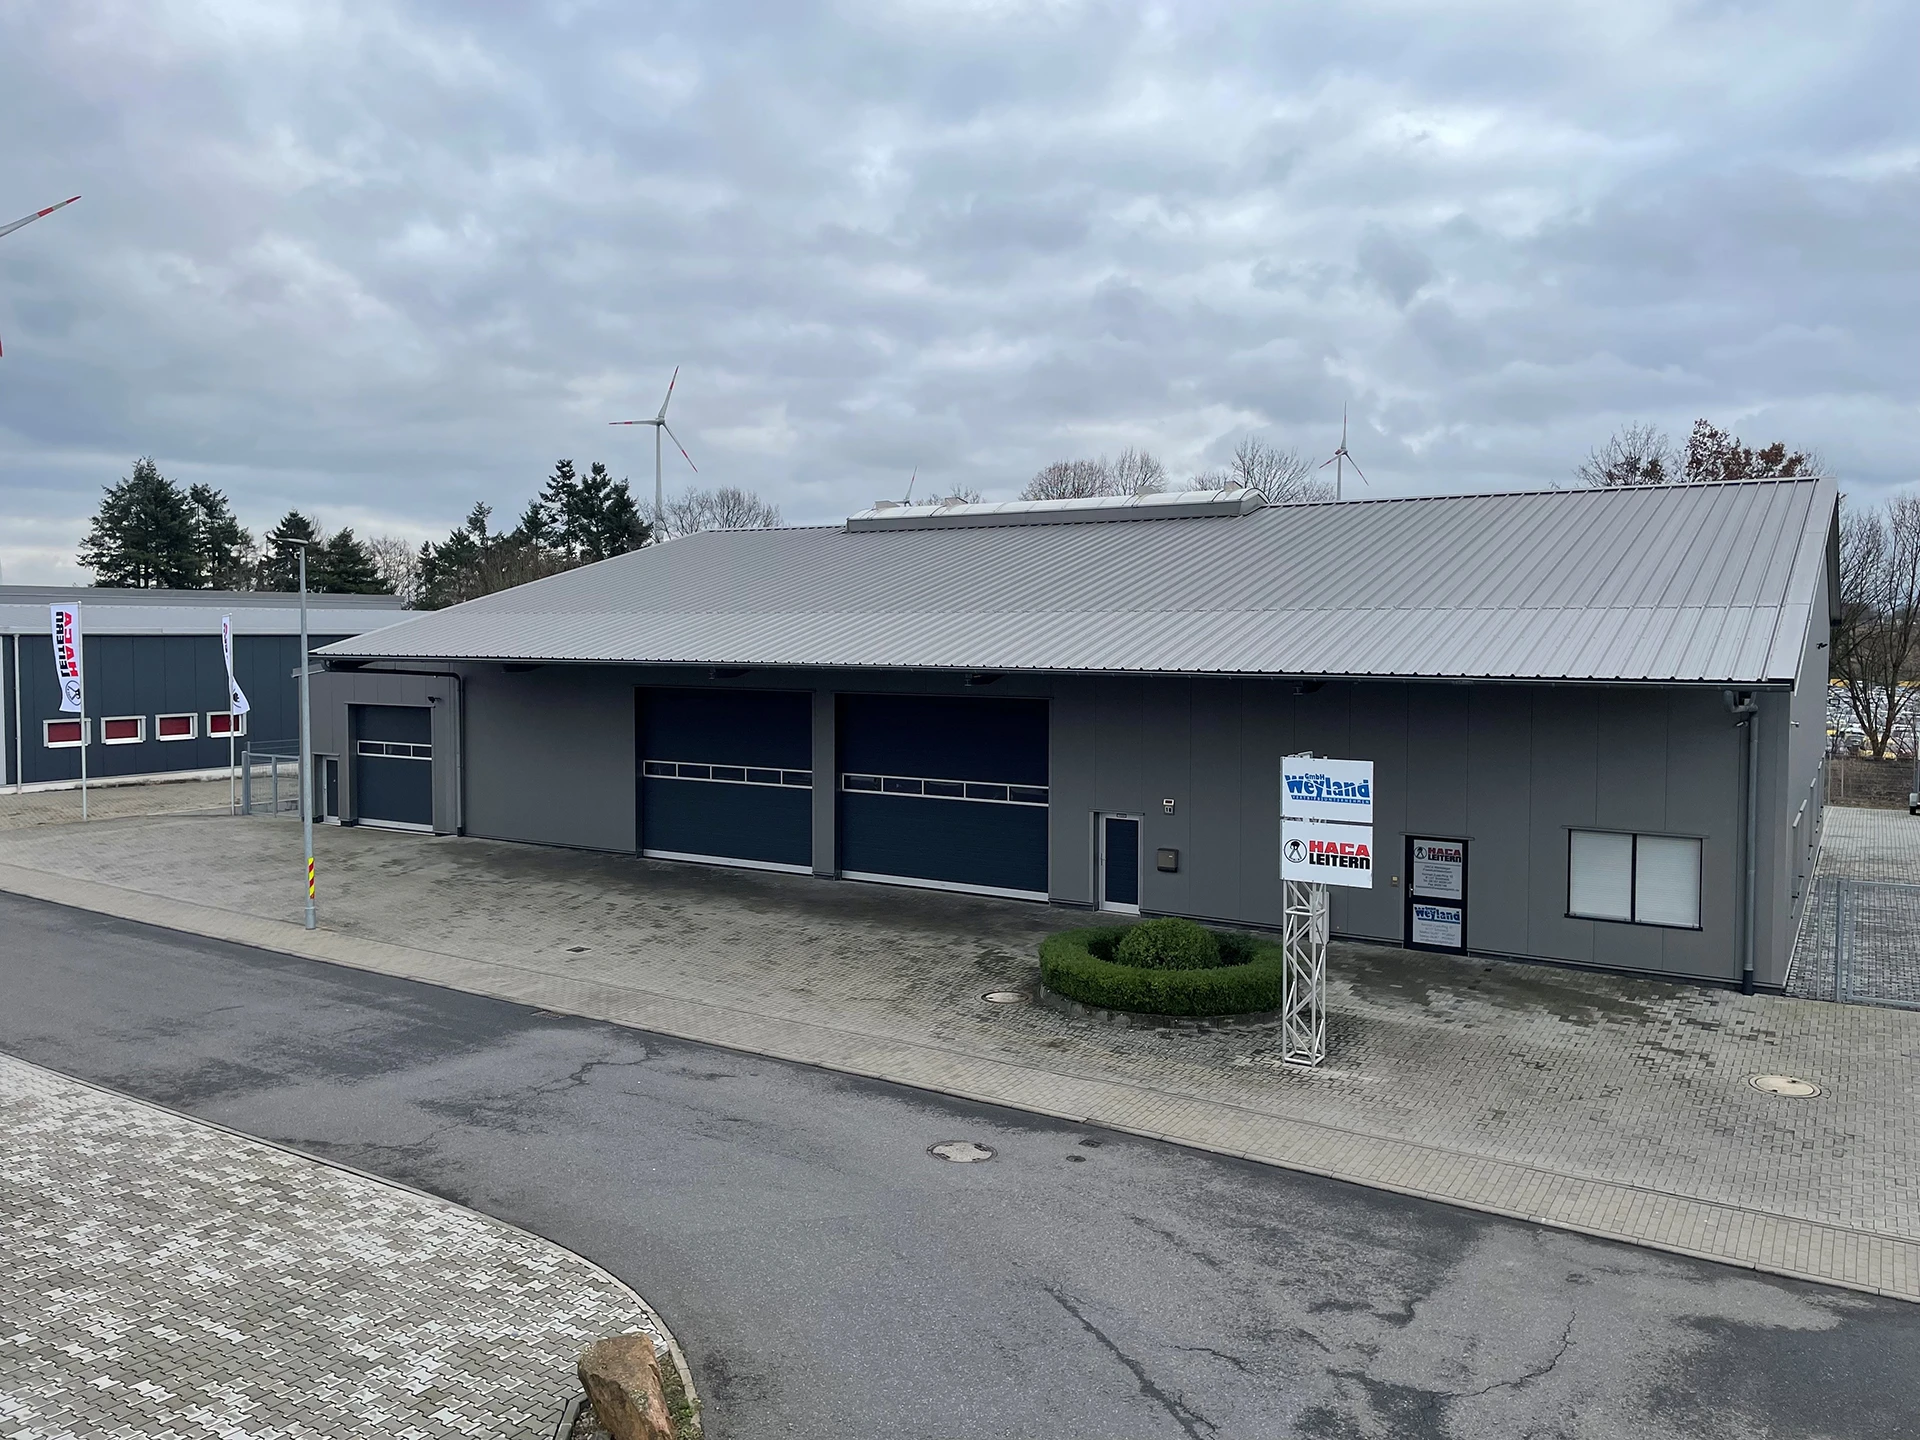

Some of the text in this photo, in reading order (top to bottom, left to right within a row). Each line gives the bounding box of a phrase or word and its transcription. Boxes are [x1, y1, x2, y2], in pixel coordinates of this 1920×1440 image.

[1284, 775, 1370, 801] Weyland
[1309, 840, 1370, 857] HACA
[1427, 847, 1461, 856] HACA
[1309, 853, 1371, 870] LEITERN
[1427, 854, 1462, 863] LEITERN
[1414, 906, 1460, 921] Weyland
